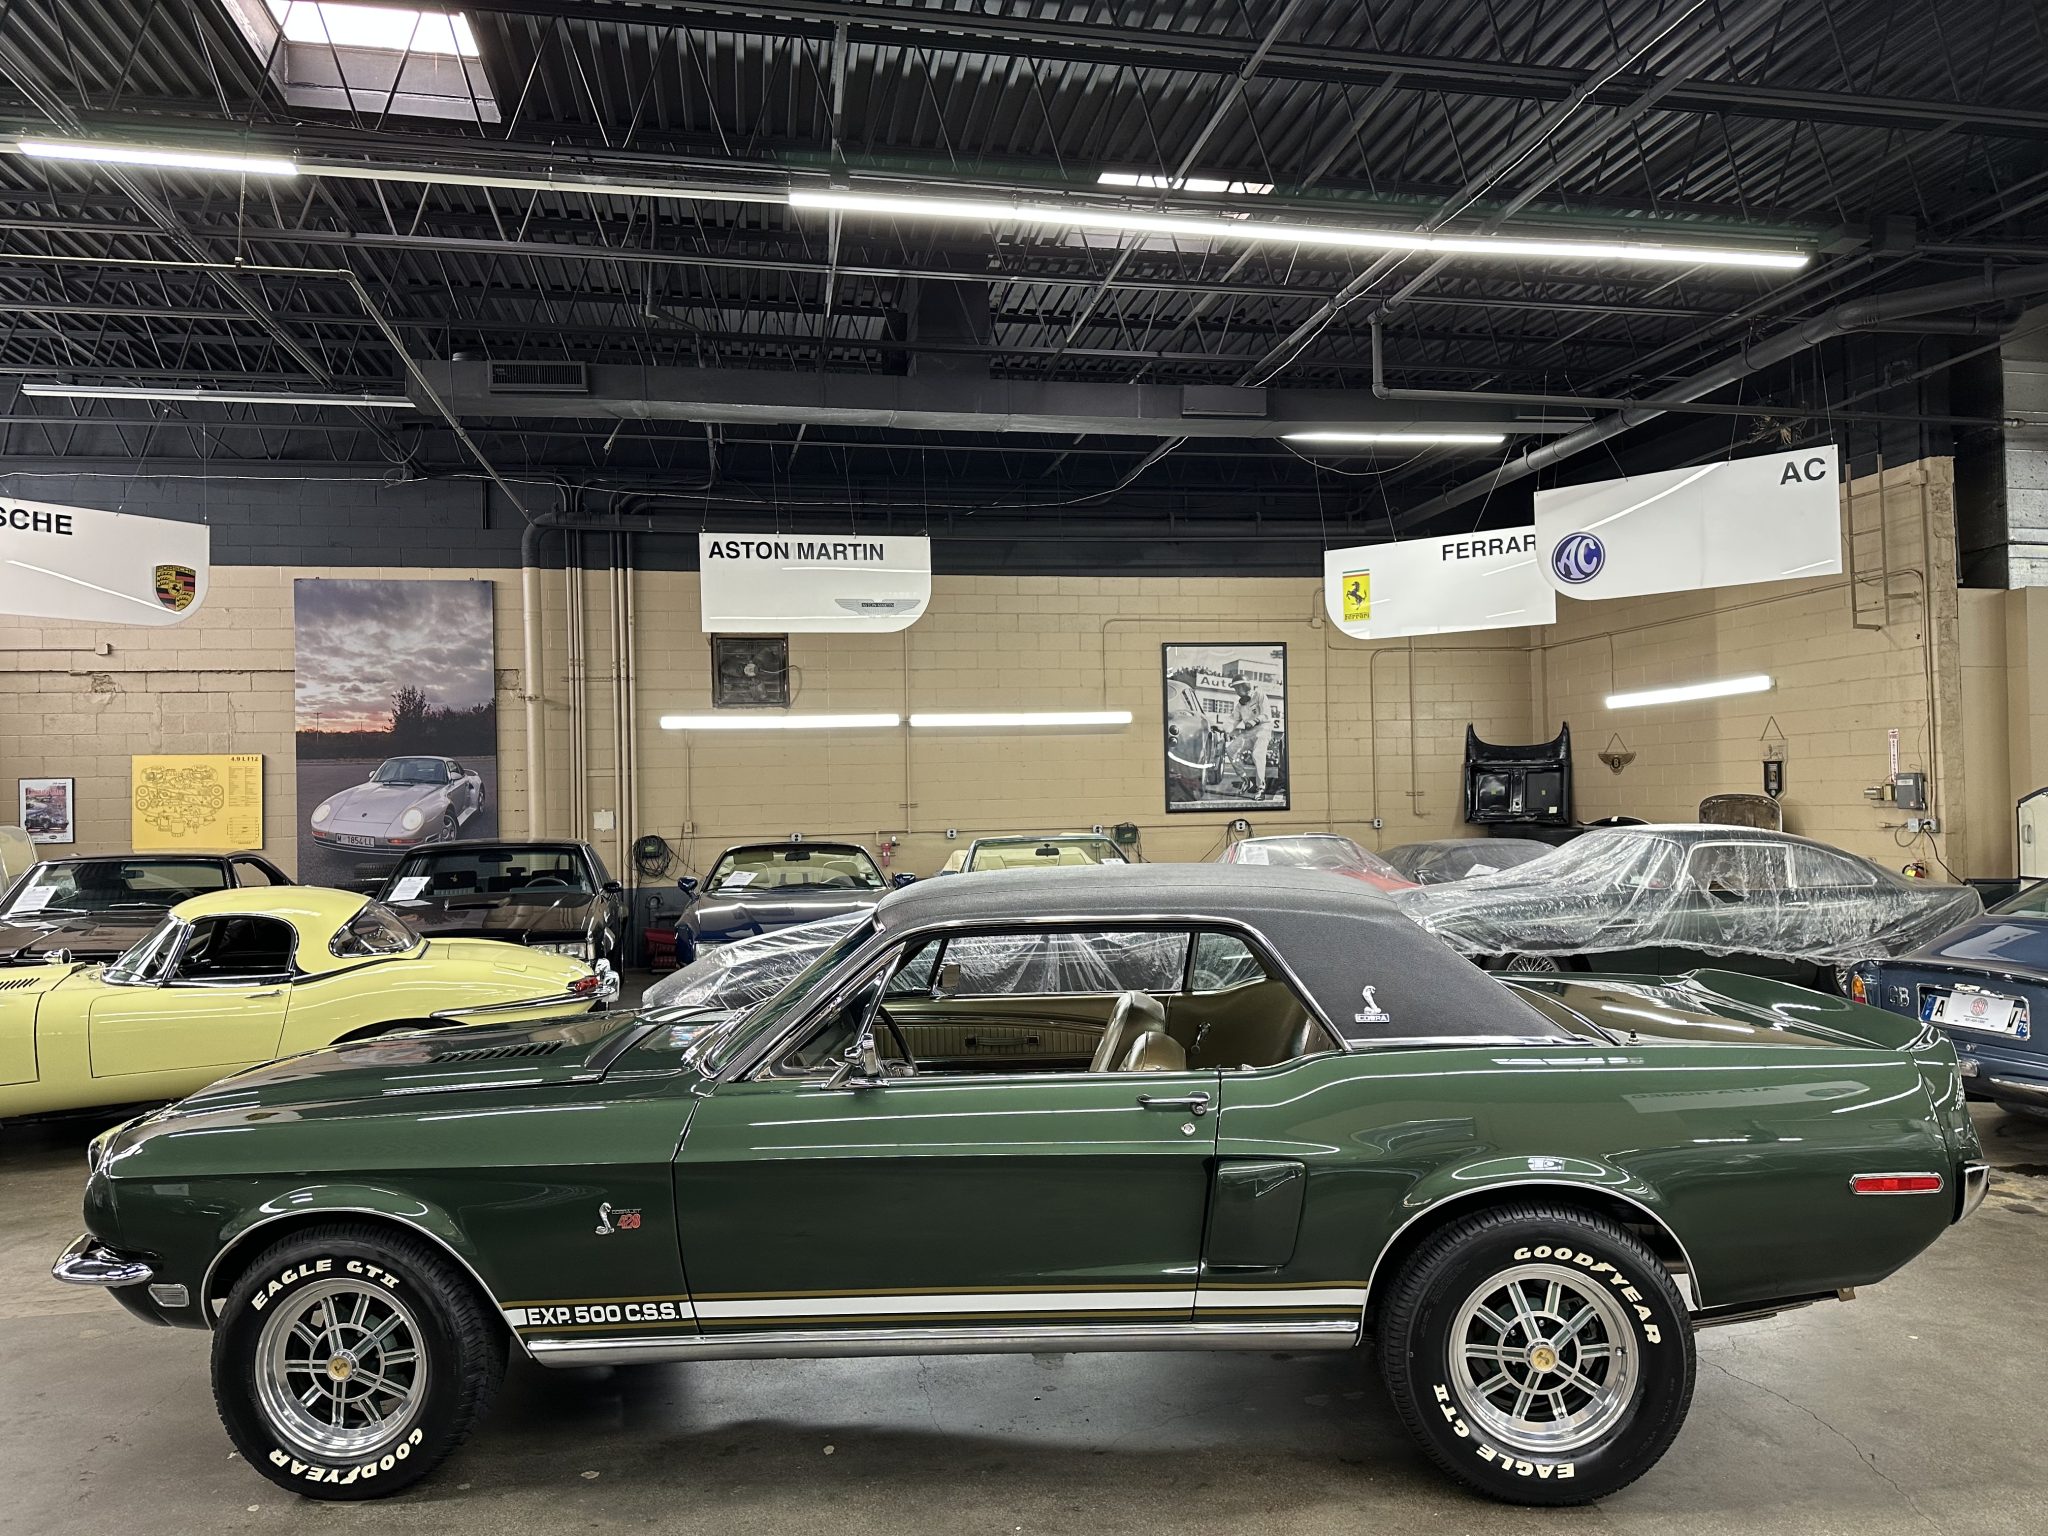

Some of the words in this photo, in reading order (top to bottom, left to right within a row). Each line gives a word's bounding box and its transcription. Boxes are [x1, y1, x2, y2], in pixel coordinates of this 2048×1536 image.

[1779, 457, 1827, 485] AC
[708, 541, 790, 560] ASTON
[796, 542, 884, 561] MARTIN
[1556, 536, 1598, 580] AC
[1344, 611, 1370, 621] Ferrari
[1888, 985, 1910, 1007] GB
[2018, 1022, 2028, 1033] 75
[616, 1213, 641, 1230] 428
[251, 1259, 332, 1311] EAGLE
[1513, 1245, 1662, 1344] GOODYEAR
[527, 1307, 572, 1325] EXP.
[575, 1305, 621, 1323] 500
[624, 1302, 680, 1321] C.S.S.
[268, 1427, 423, 1485] GOODYEAR
[1476, 1443, 1575, 1479] EAGLE
